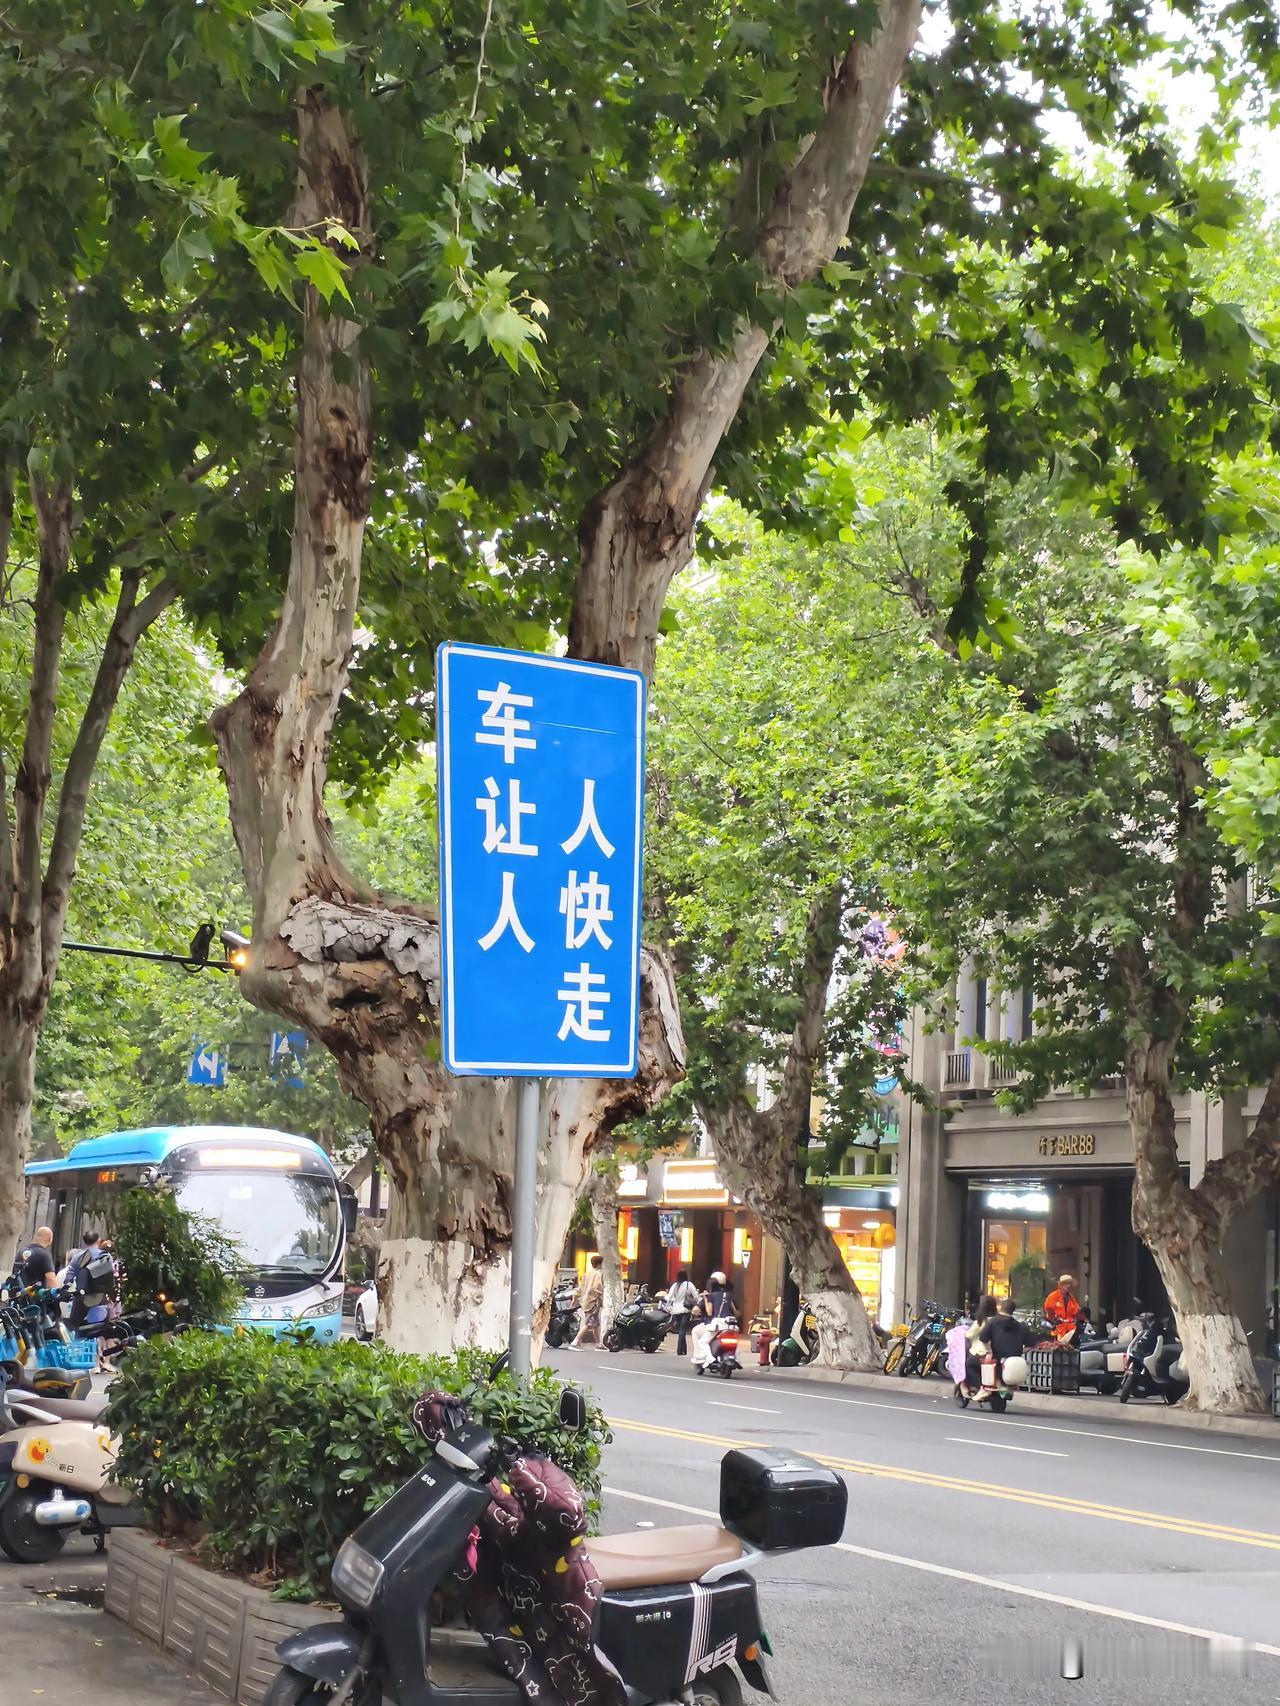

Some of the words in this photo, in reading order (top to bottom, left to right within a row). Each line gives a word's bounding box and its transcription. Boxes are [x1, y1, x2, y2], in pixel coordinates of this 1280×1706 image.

[475, 681, 540, 954] 车让人
[557, 777, 617, 1042] 人快走
[687, 1636, 738, 1683] RS
